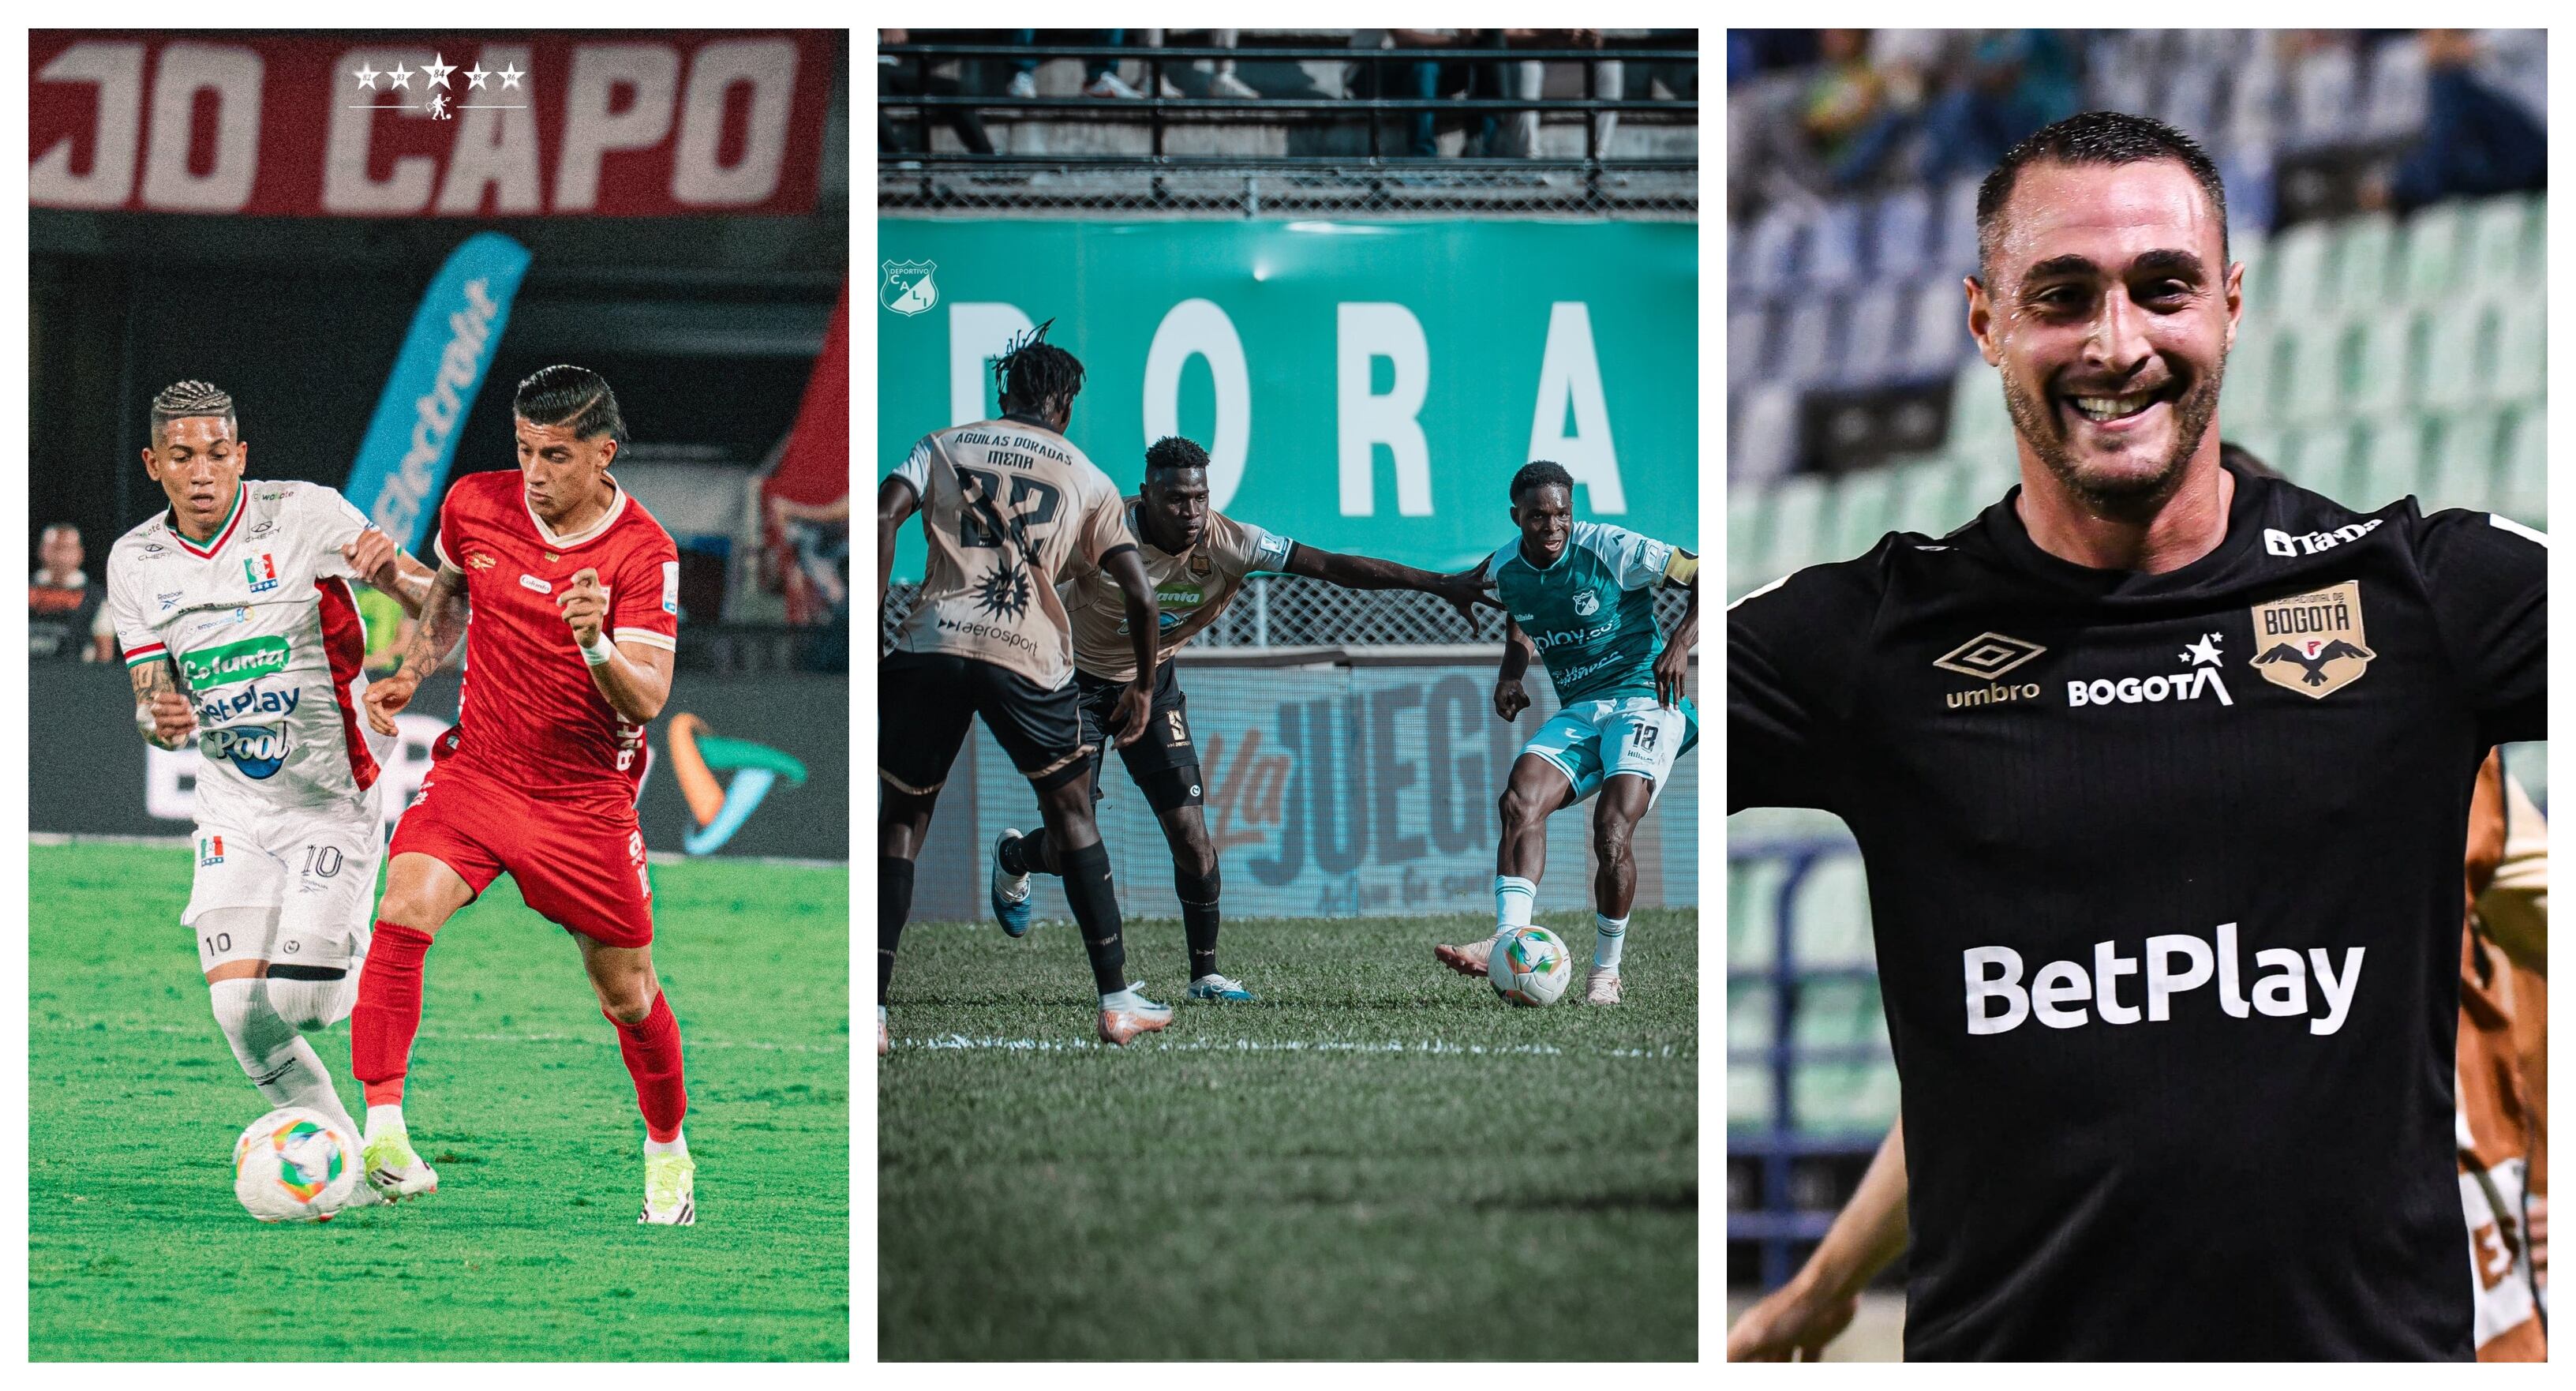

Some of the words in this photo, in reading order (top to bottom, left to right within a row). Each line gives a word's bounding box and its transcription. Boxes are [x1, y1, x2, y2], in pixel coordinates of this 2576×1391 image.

[322, 38, 799, 215] CAPO
[987, 449, 1035, 471] MENA
[1013, 437, 1073, 467] DORADAS
[245, 527, 282, 542] CHERY
[157, 589, 185, 601] Reebok
[2263, 600, 2350, 636] BOGOTÁ
[962, 621, 1039, 658] aerosport
[1945, 681, 2041, 709] umbro
[207, 721, 290, 760] Pool
[1633, 722, 1659, 754] 18
[301, 844, 343, 878] 10
[205, 932, 232, 957] 10
[1964, 922, 2366, 1036] BetPlay
